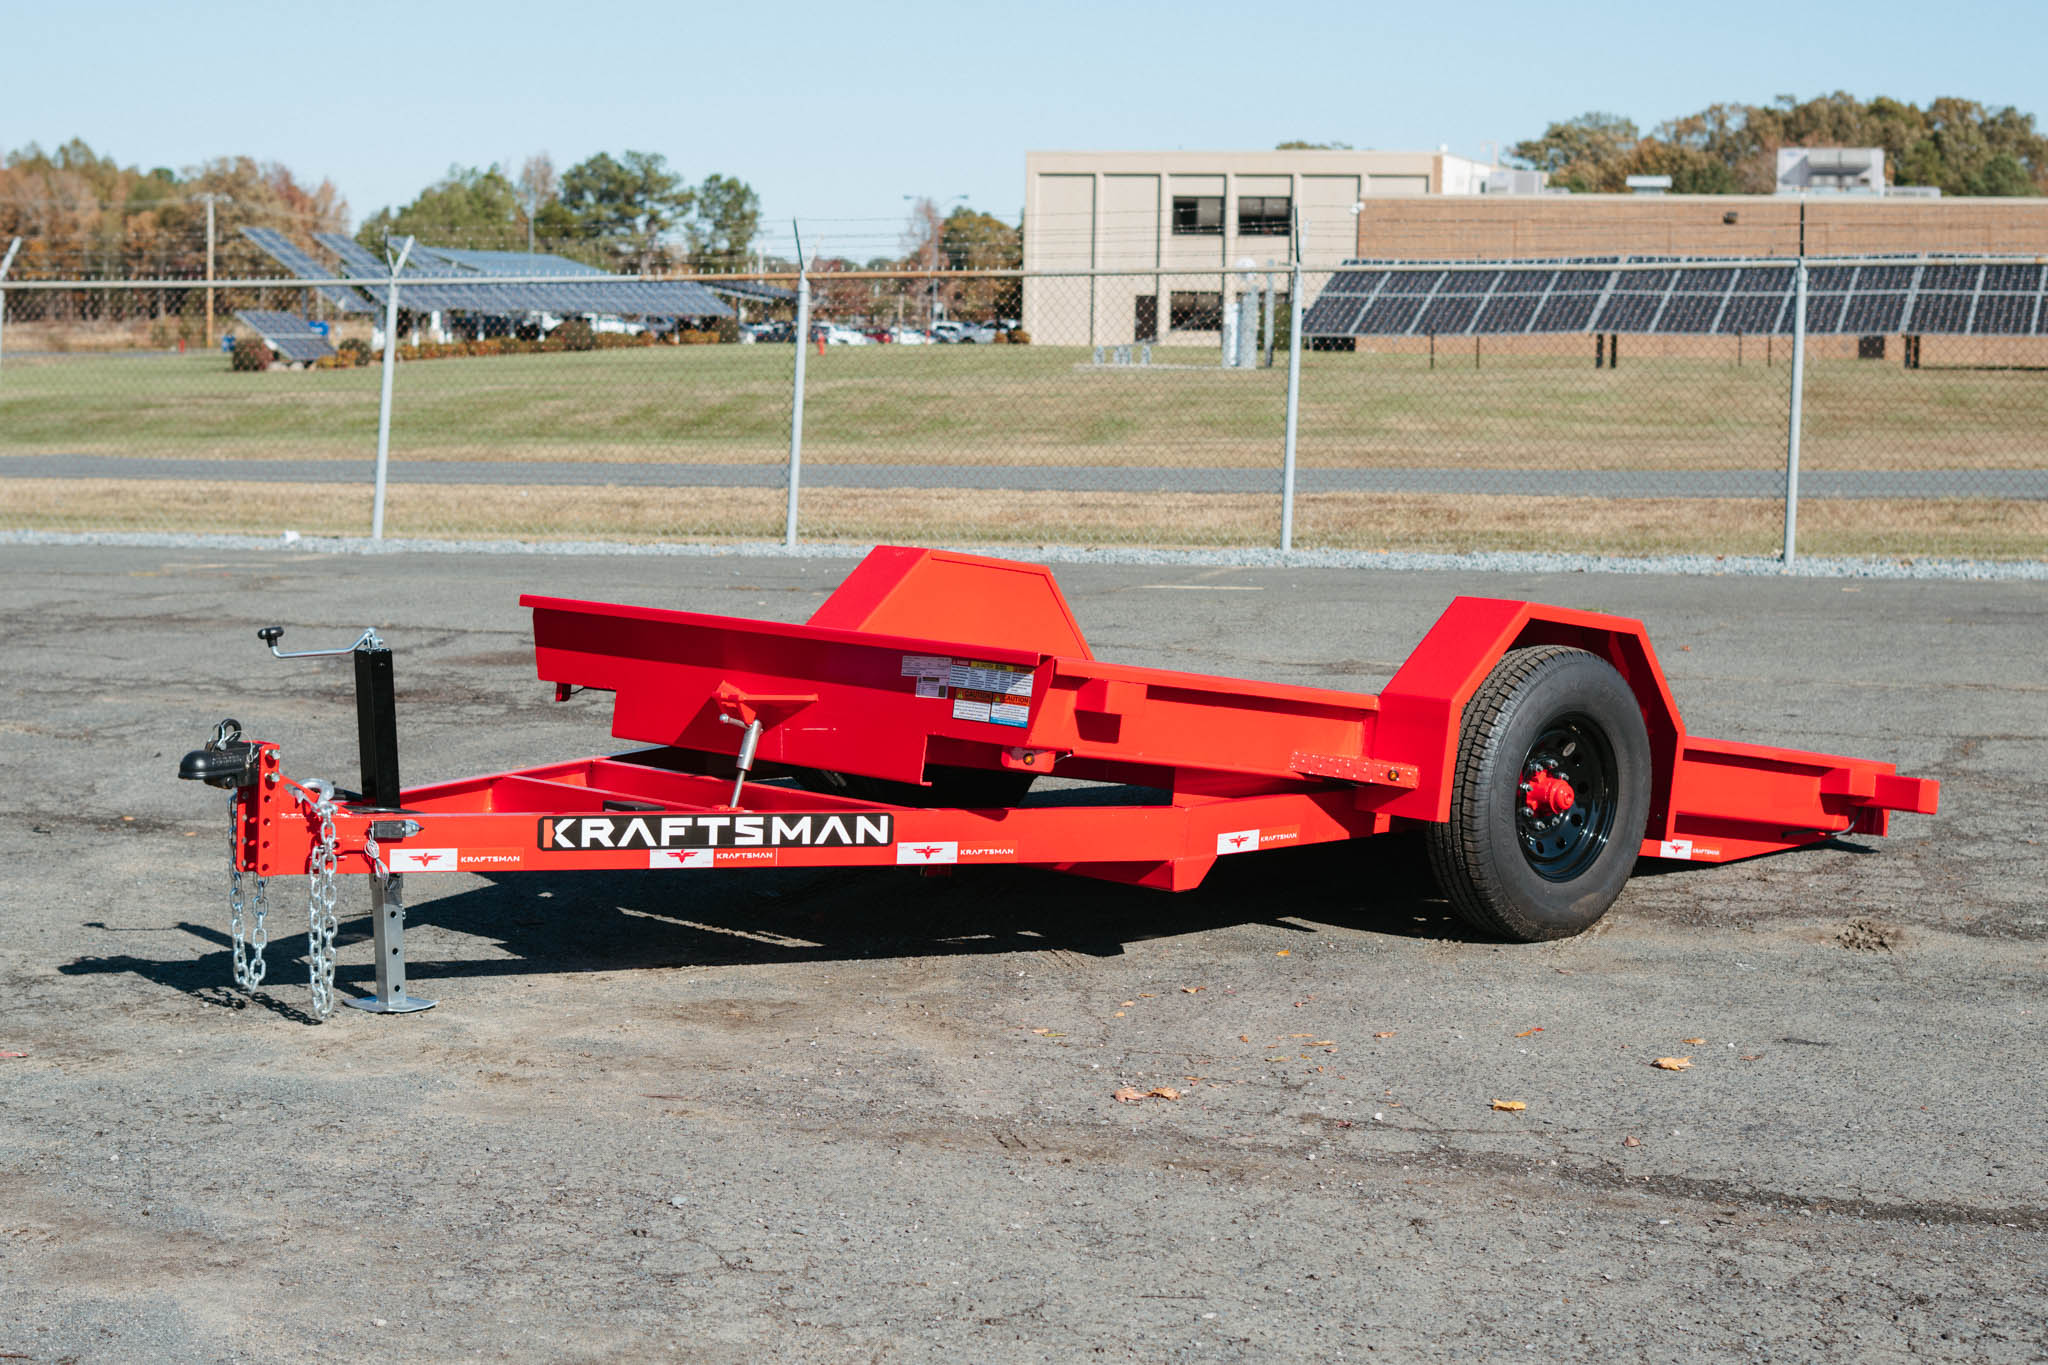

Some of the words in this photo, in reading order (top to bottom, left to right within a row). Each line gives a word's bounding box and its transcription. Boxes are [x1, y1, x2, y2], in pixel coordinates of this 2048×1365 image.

[1001, 695, 1029, 703] CAUTION
[543, 815, 889, 848] KRAFTSMAN
[1260, 832, 1298, 843] KRAFTSMAN
[716, 852, 773, 860] KRAFTSMAN
[960, 848, 1015, 856] KRAFTSMAN
[460, 855, 521, 863] KRAFTSMAN
